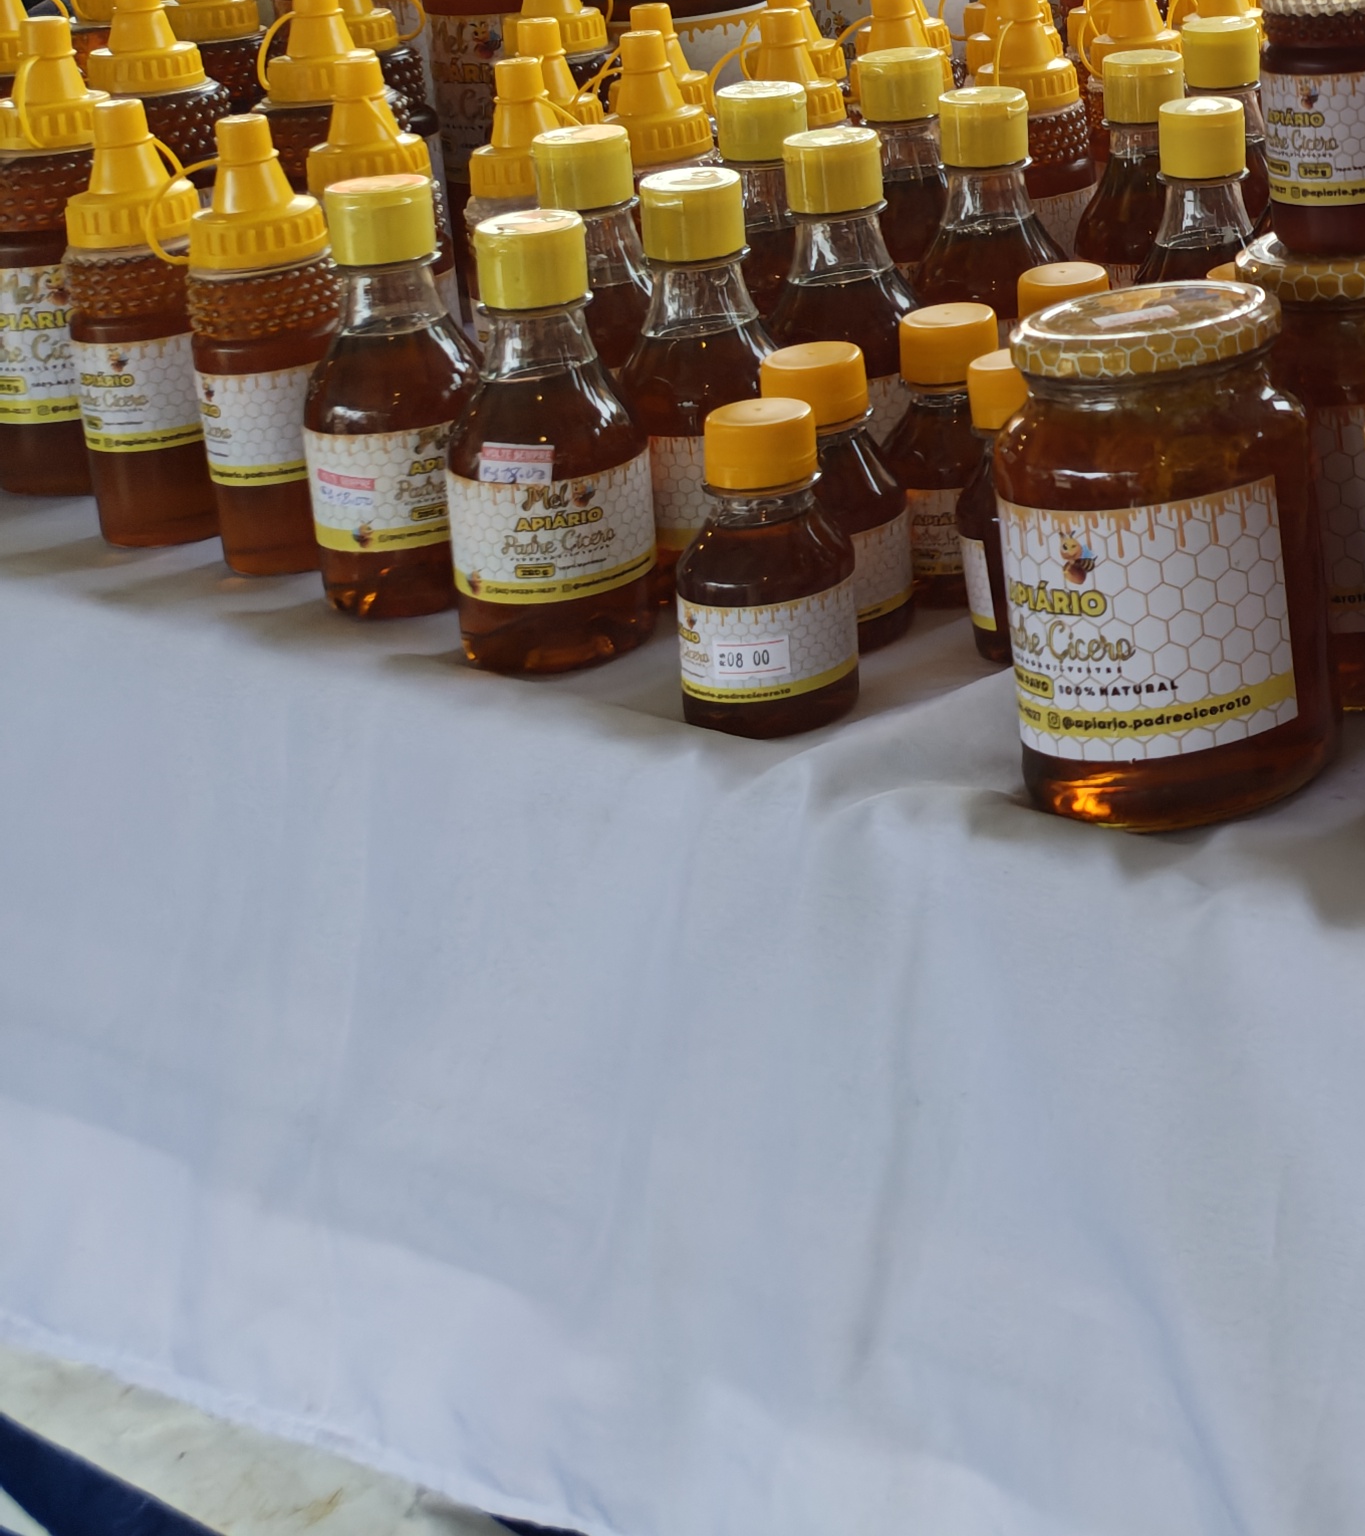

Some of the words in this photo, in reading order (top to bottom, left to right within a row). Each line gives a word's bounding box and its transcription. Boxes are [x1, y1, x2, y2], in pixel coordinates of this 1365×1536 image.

[522, 484, 569, 511] Mel
[515, 506, 603, 532] APIÁRIO
[501, 532, 557, 557] Padre
[727, 651, 744, 669] 08
[753, 649, 770, 665] 00
[1058, 684, 1095, 697] 100%
[1100, 680, 1179, 697] NATURAL
[1063, 694, 1251, 731] @apiario.padrecicero10
